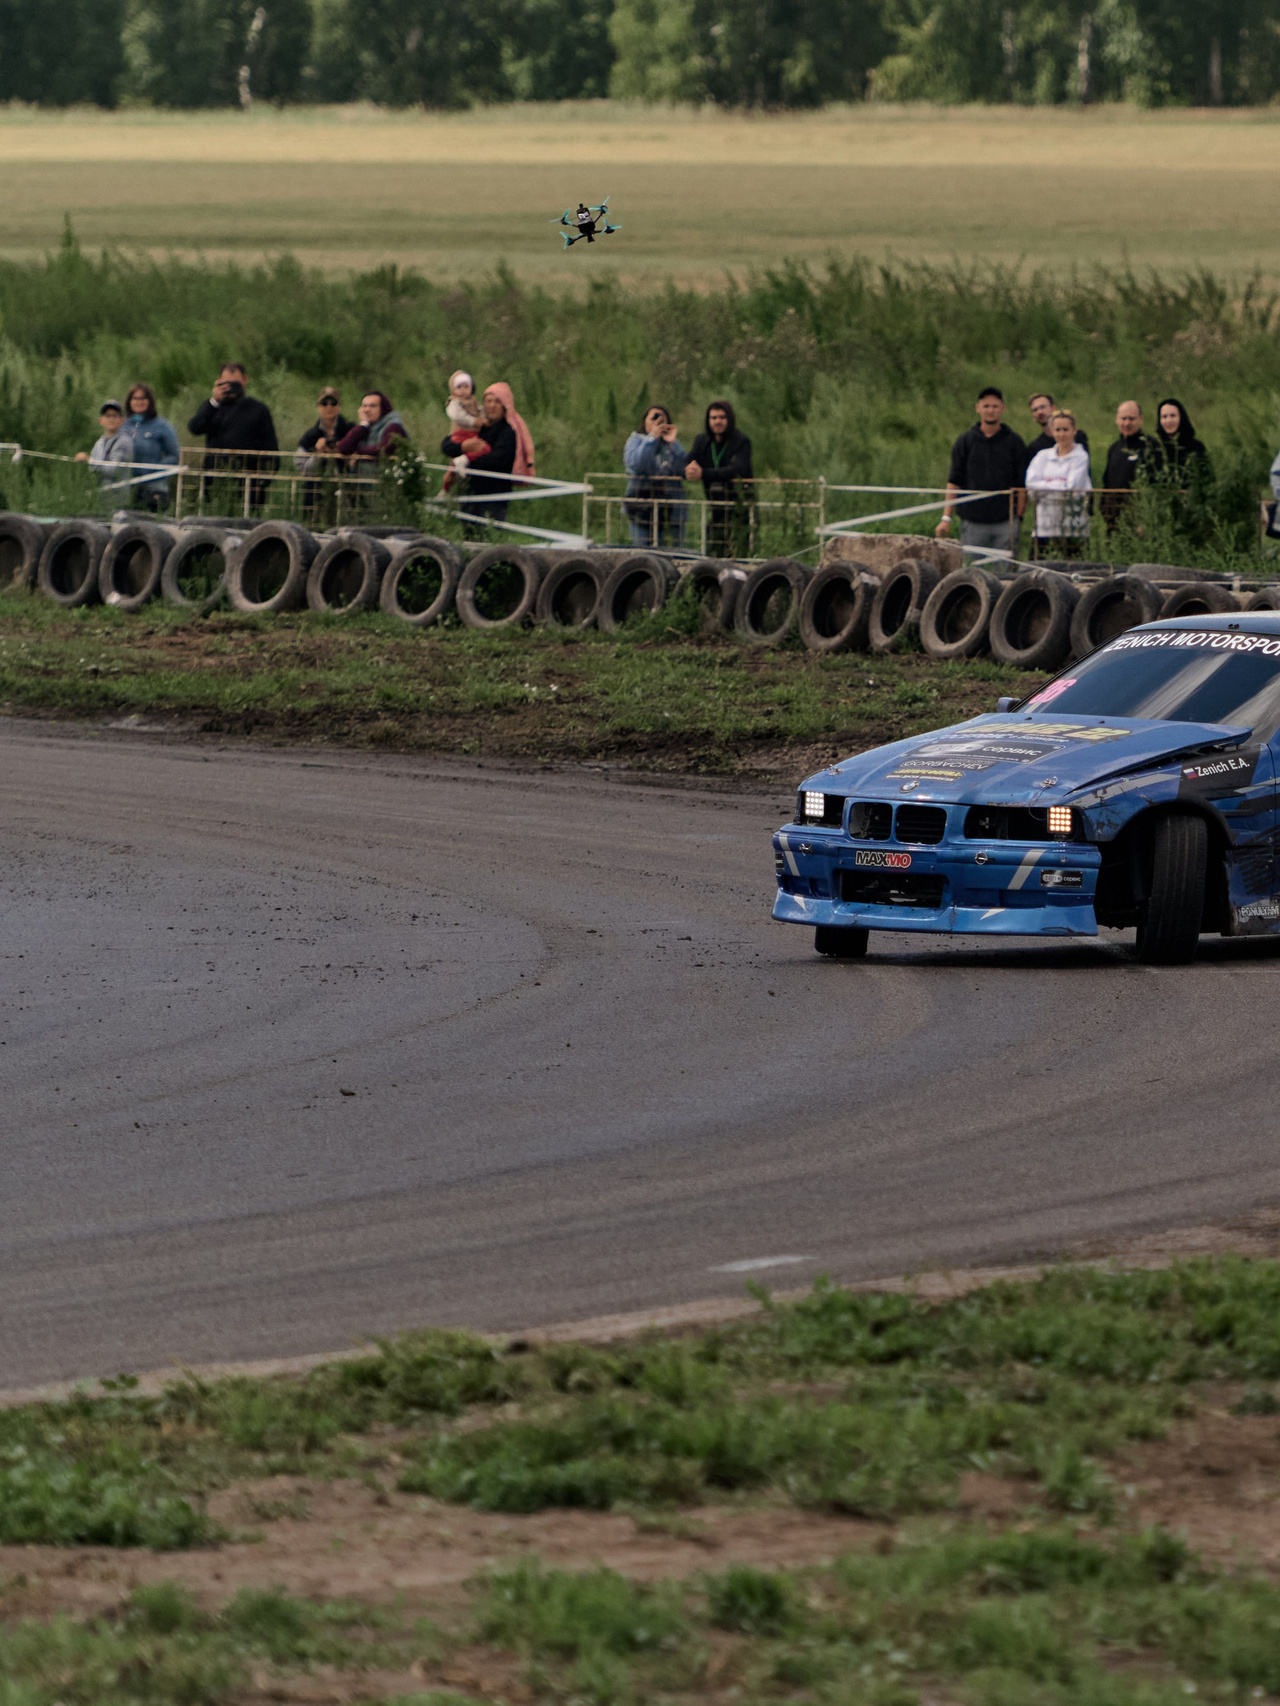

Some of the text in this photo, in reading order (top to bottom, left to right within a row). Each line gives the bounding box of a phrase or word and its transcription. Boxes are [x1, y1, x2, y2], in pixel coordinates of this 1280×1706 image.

[1103, 633, 1175, 653] ZENICH
[1028, 678, 1078, 705] 36
[1195, 757, 1250, 777] Zenich E.A.
[855, 850, 912, 869] MAXMO
